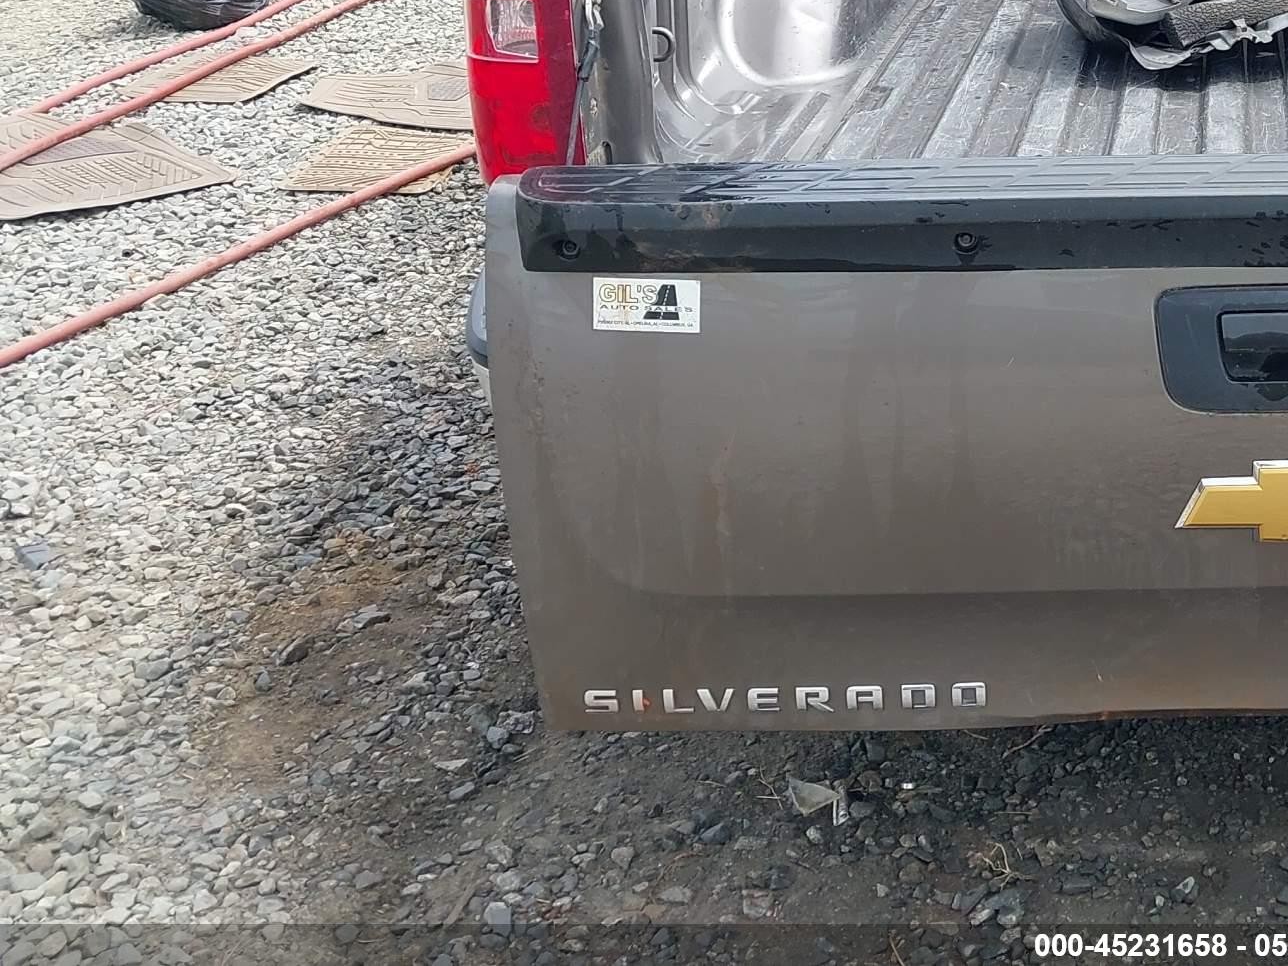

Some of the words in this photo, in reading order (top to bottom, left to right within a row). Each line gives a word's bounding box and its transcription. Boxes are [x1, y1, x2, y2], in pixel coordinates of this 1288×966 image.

[599, 283, 658, 306] GIL'S
[643, 305, 694, 313] SALES
[583, 681, 988, 714] SILVERADO
